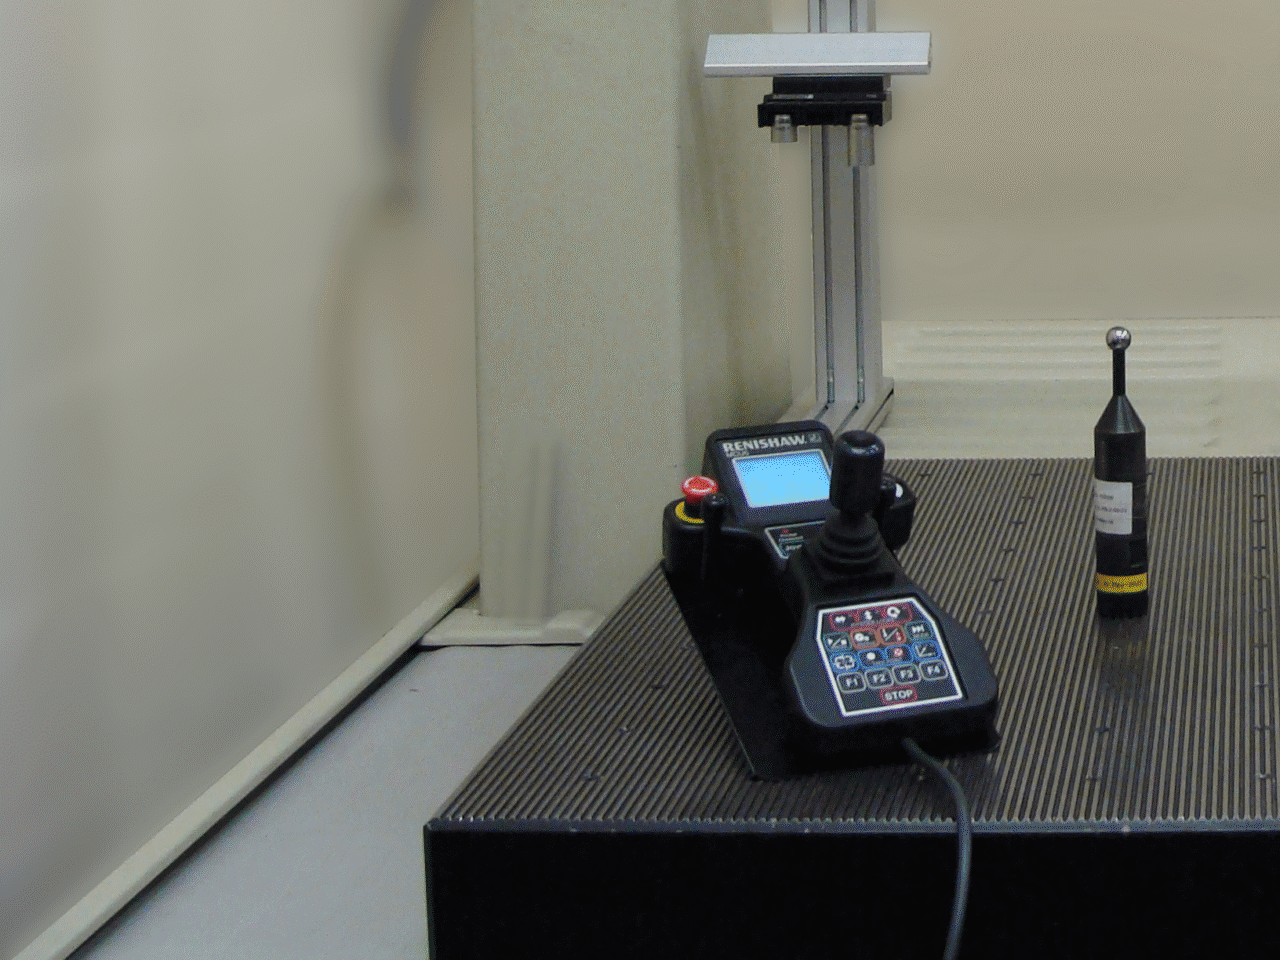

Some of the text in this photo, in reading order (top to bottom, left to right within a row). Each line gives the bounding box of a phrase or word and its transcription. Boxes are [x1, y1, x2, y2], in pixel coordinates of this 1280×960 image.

[722, 434, 807, 453] RENISHAW
[845, 678, 859, 688] F1
[872, 674, 887, 683] F2
[926, 665, 941, 675] F4
[884, 690, 914, 701] STOP
